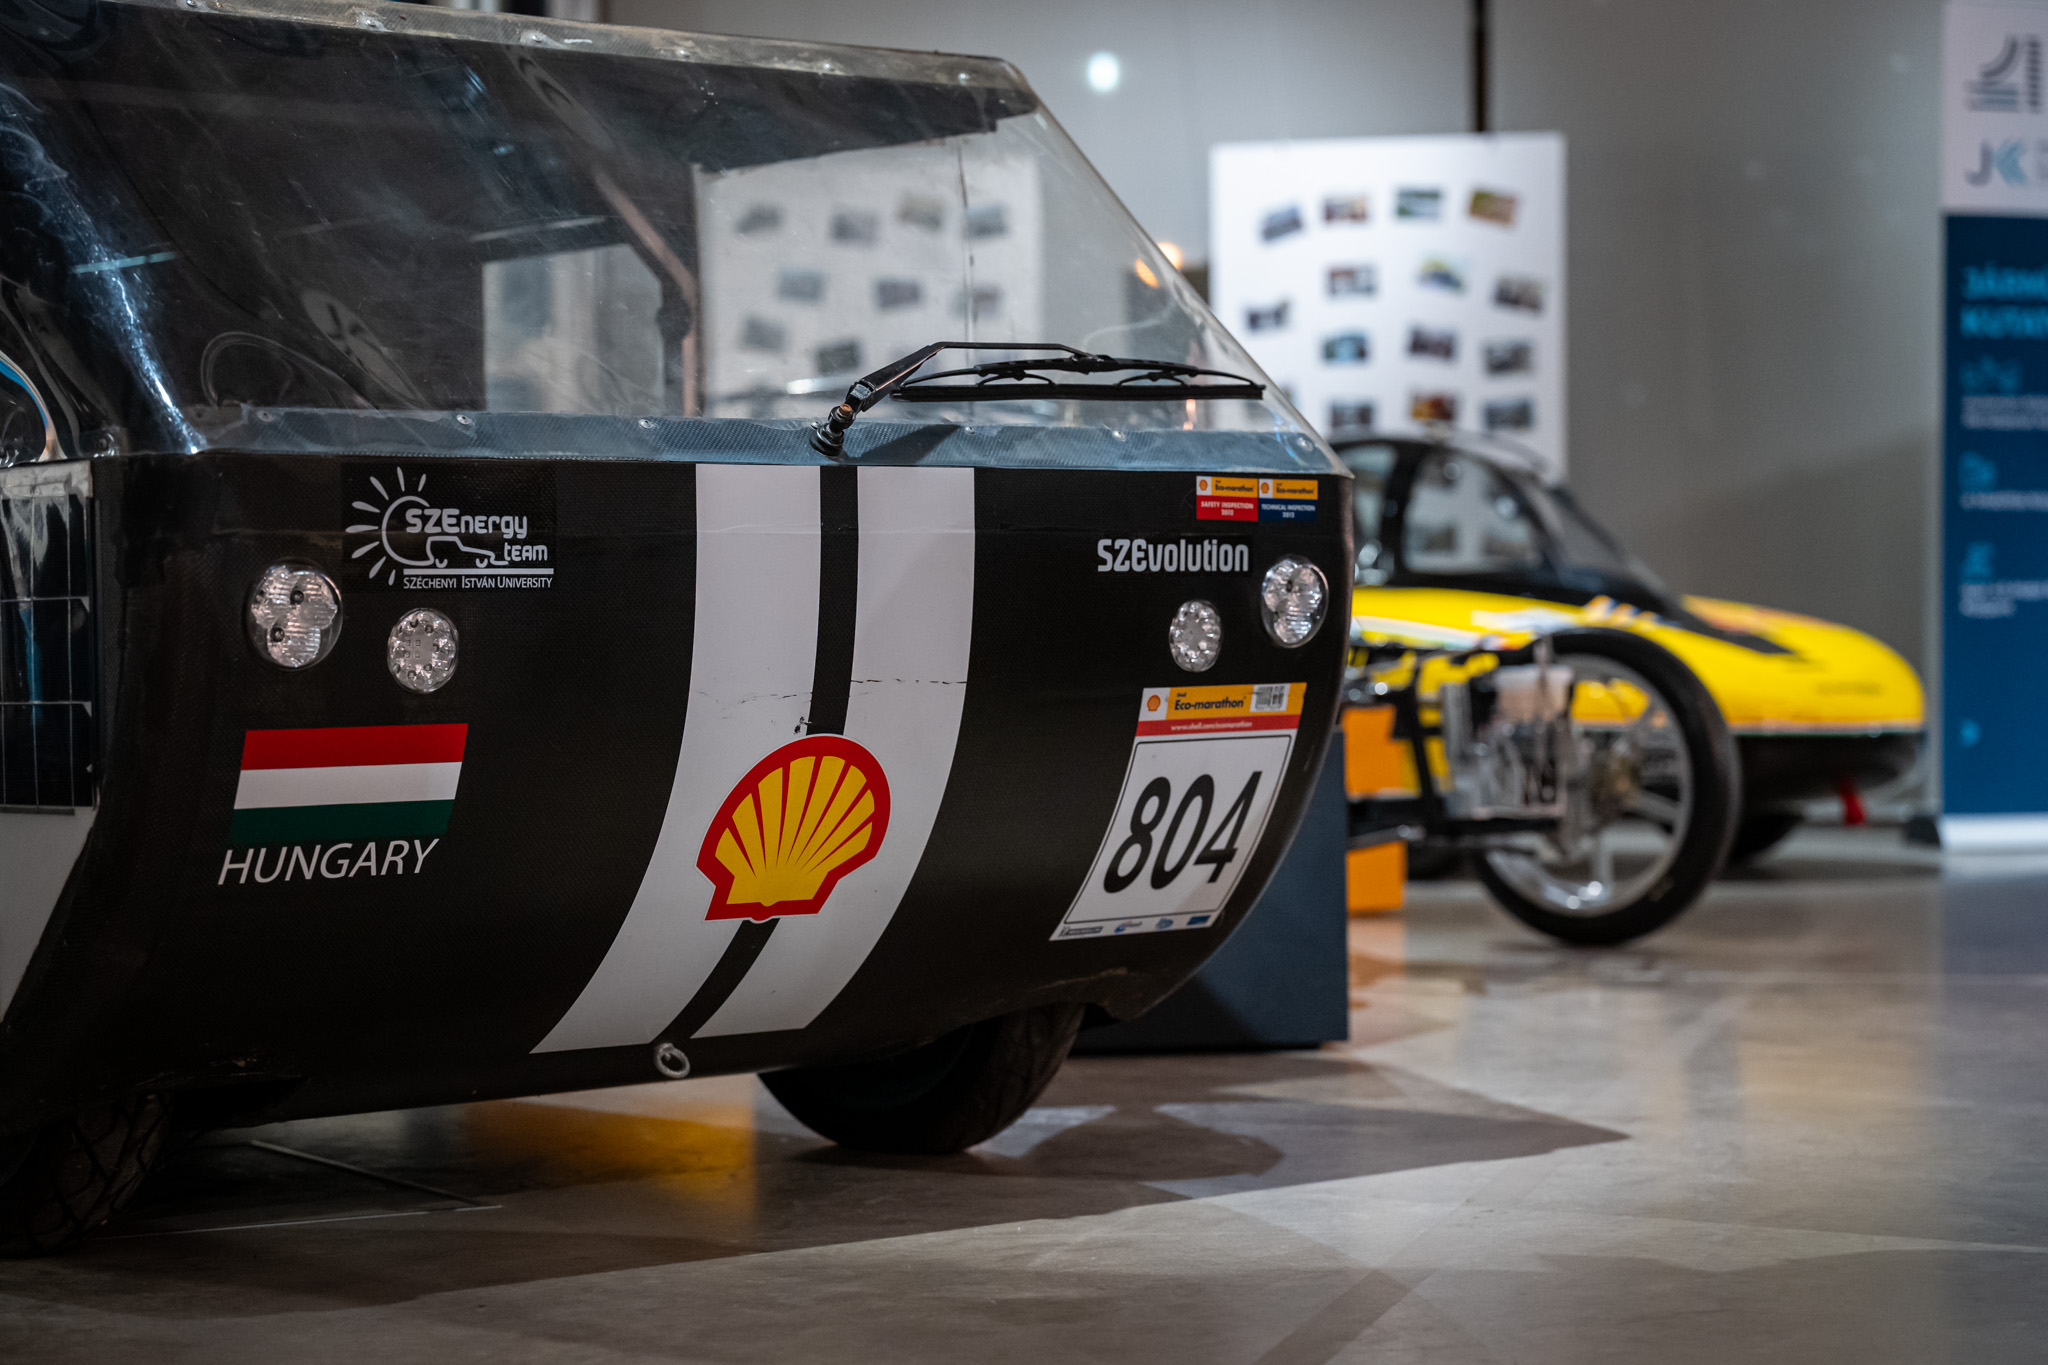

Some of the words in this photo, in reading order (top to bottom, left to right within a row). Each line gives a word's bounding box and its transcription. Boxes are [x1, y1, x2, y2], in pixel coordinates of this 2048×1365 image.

[1261, 503, 1286, 511] TECHNICAL
[1097, 538, 1249, 572] SZEvolution
[403, 575, 457, 589] SZÉCHENYI
[461, 575, 496, 589] ISTVÁN
[497, 576, 553, 589] UNIVERSITY
[1174, 696, 1244, 711] Eco-marathon
[1103, 771, 1263, 893] 804
[217, 838, 440, 886] HUNGARY
